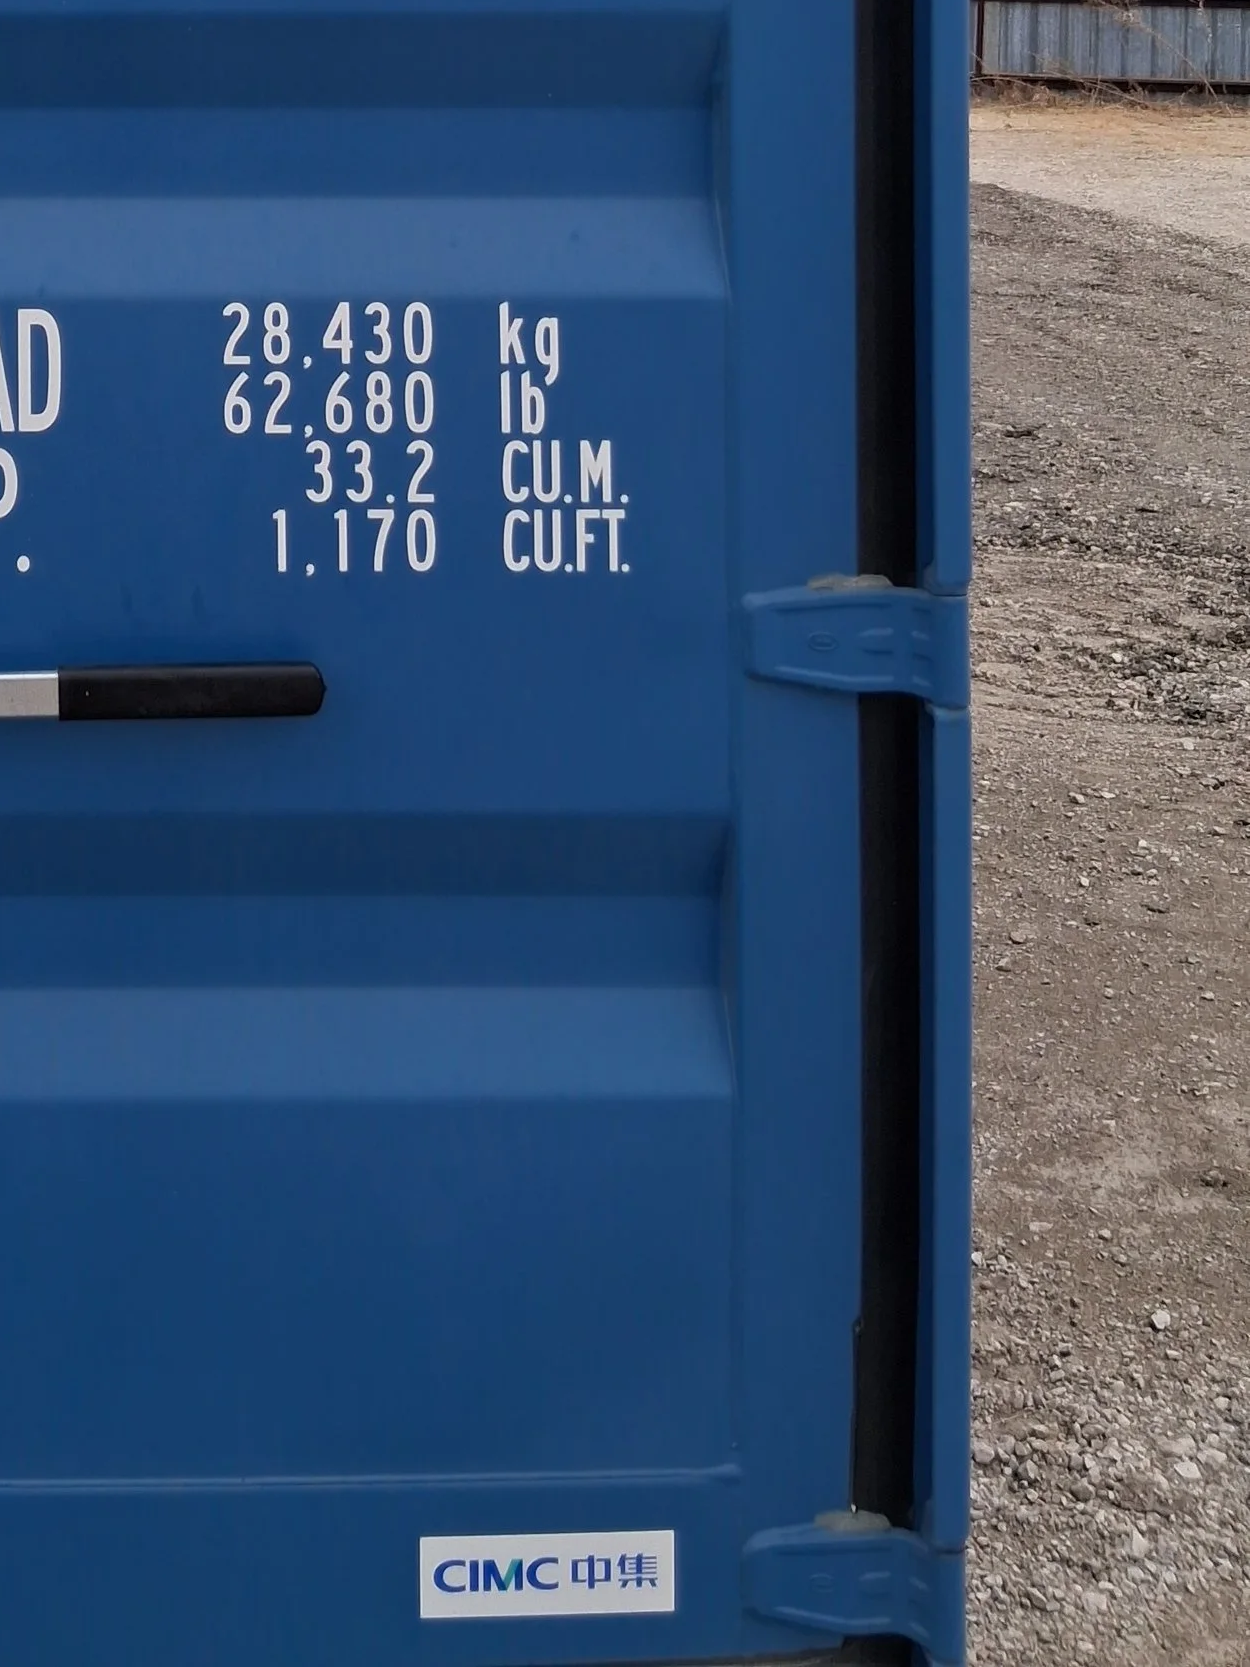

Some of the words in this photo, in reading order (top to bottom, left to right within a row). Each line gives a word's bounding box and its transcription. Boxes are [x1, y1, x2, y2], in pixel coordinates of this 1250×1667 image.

[222, 301, 433, 369] 28,430
[499, 301, 560, 386] kg
[224, 370, 434, 438] 62,680
[500, 370, 546, 435] lb
[305, 439, 435, 504] 33.2
[502, 439, 629, 504] CU.M.
[272, 508, 437, 577] 1,170
[503, 508, 630, 573] CU.FT.
[433, 1557, 559, 1593] CIMC
[571, 1552, 658, 1589] 中集
